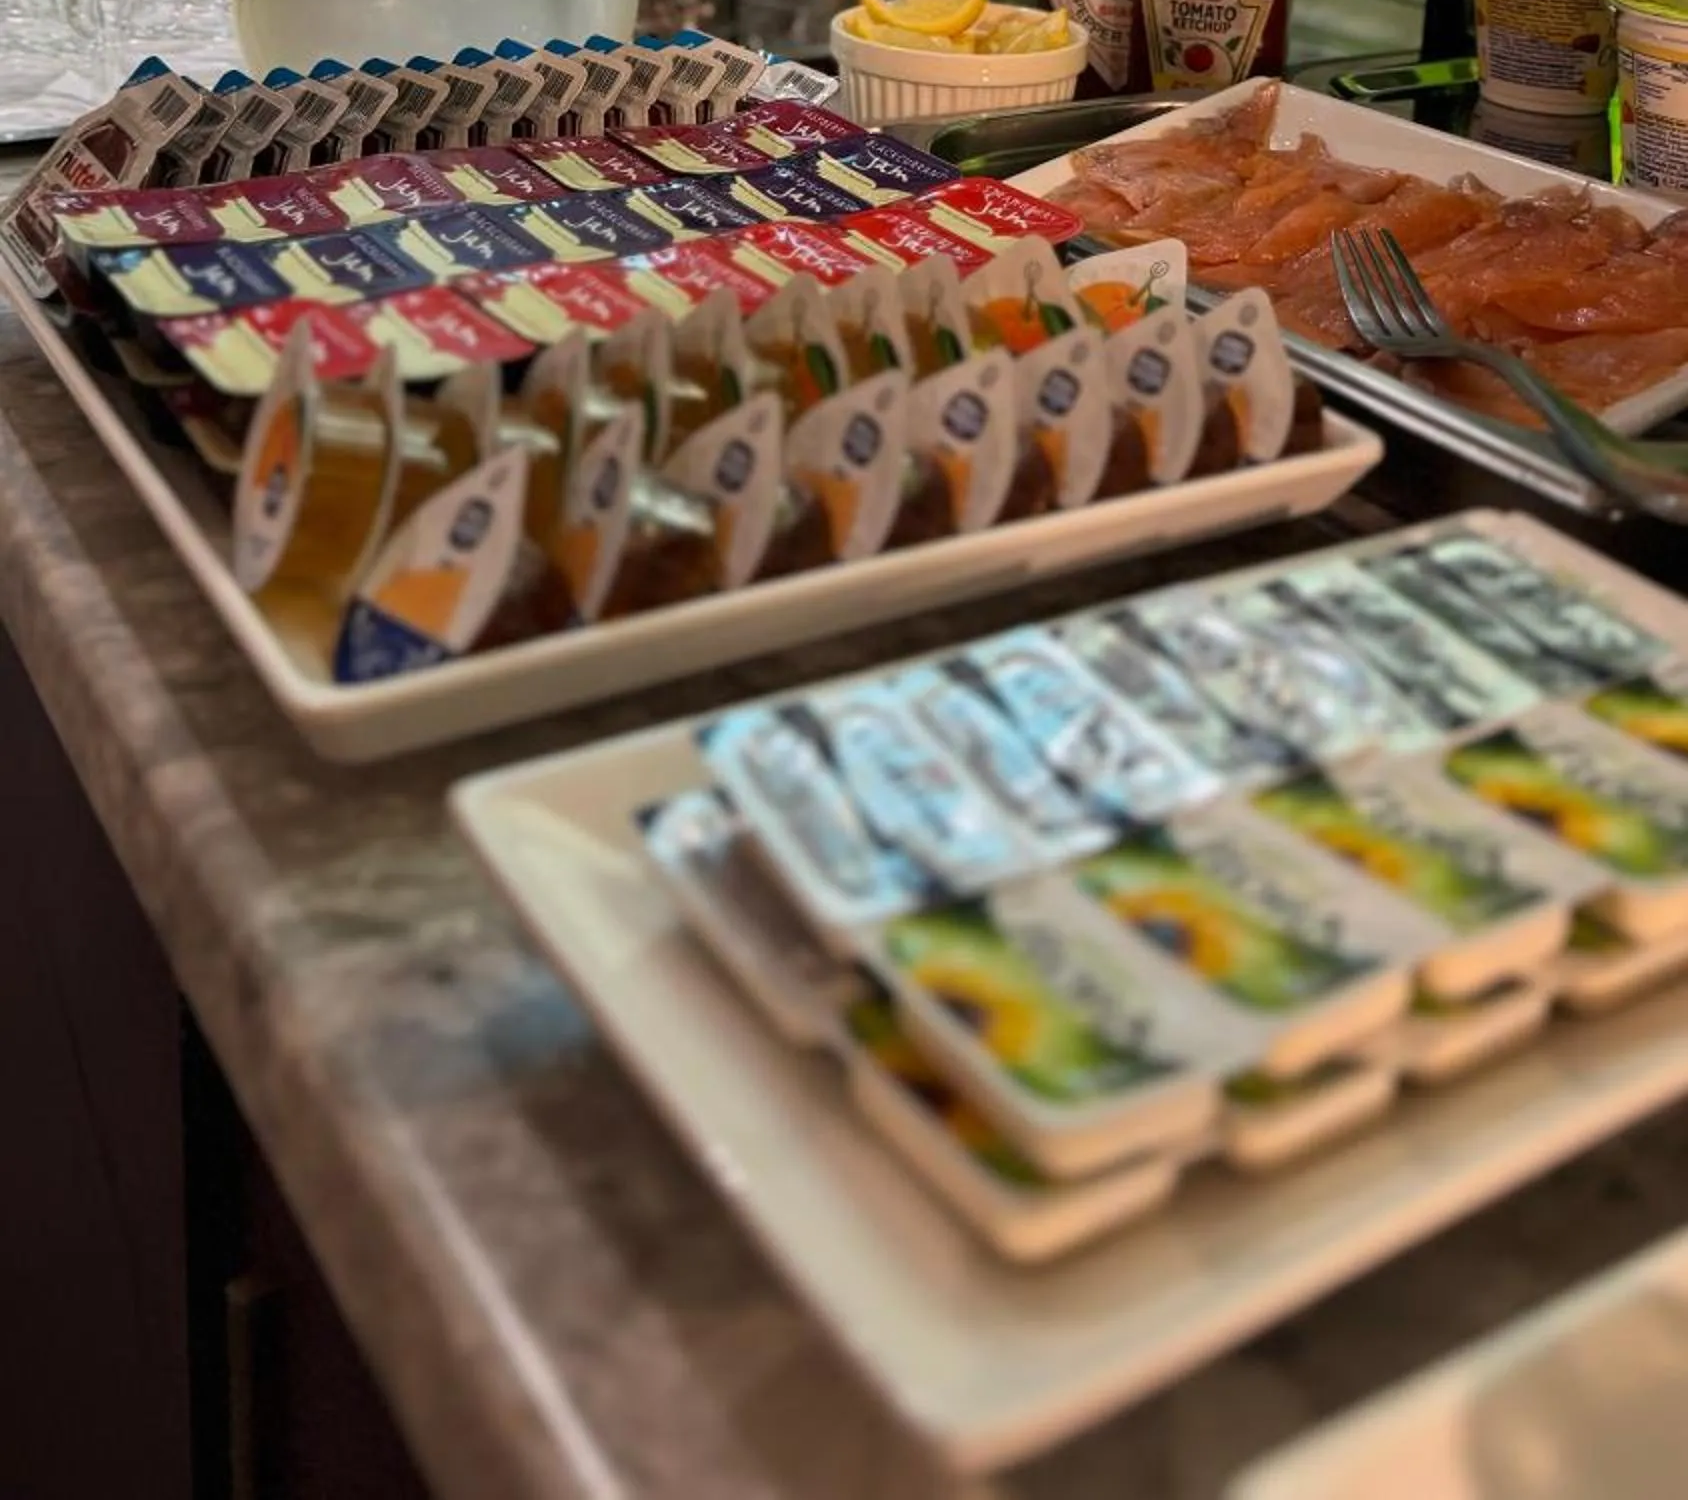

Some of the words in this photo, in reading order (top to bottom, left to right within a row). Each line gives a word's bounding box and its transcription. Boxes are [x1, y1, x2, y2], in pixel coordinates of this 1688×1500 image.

[1170, 0, 1238, 22] TOMATO
[1173, 18, 1232, 34] KETCHUP
[851, 156, 909, 183] Jam
[562, 215, 618, 244] Jam
[963, 201, 1028, 230] Jam
[439, 228, 494, 260] Jam
